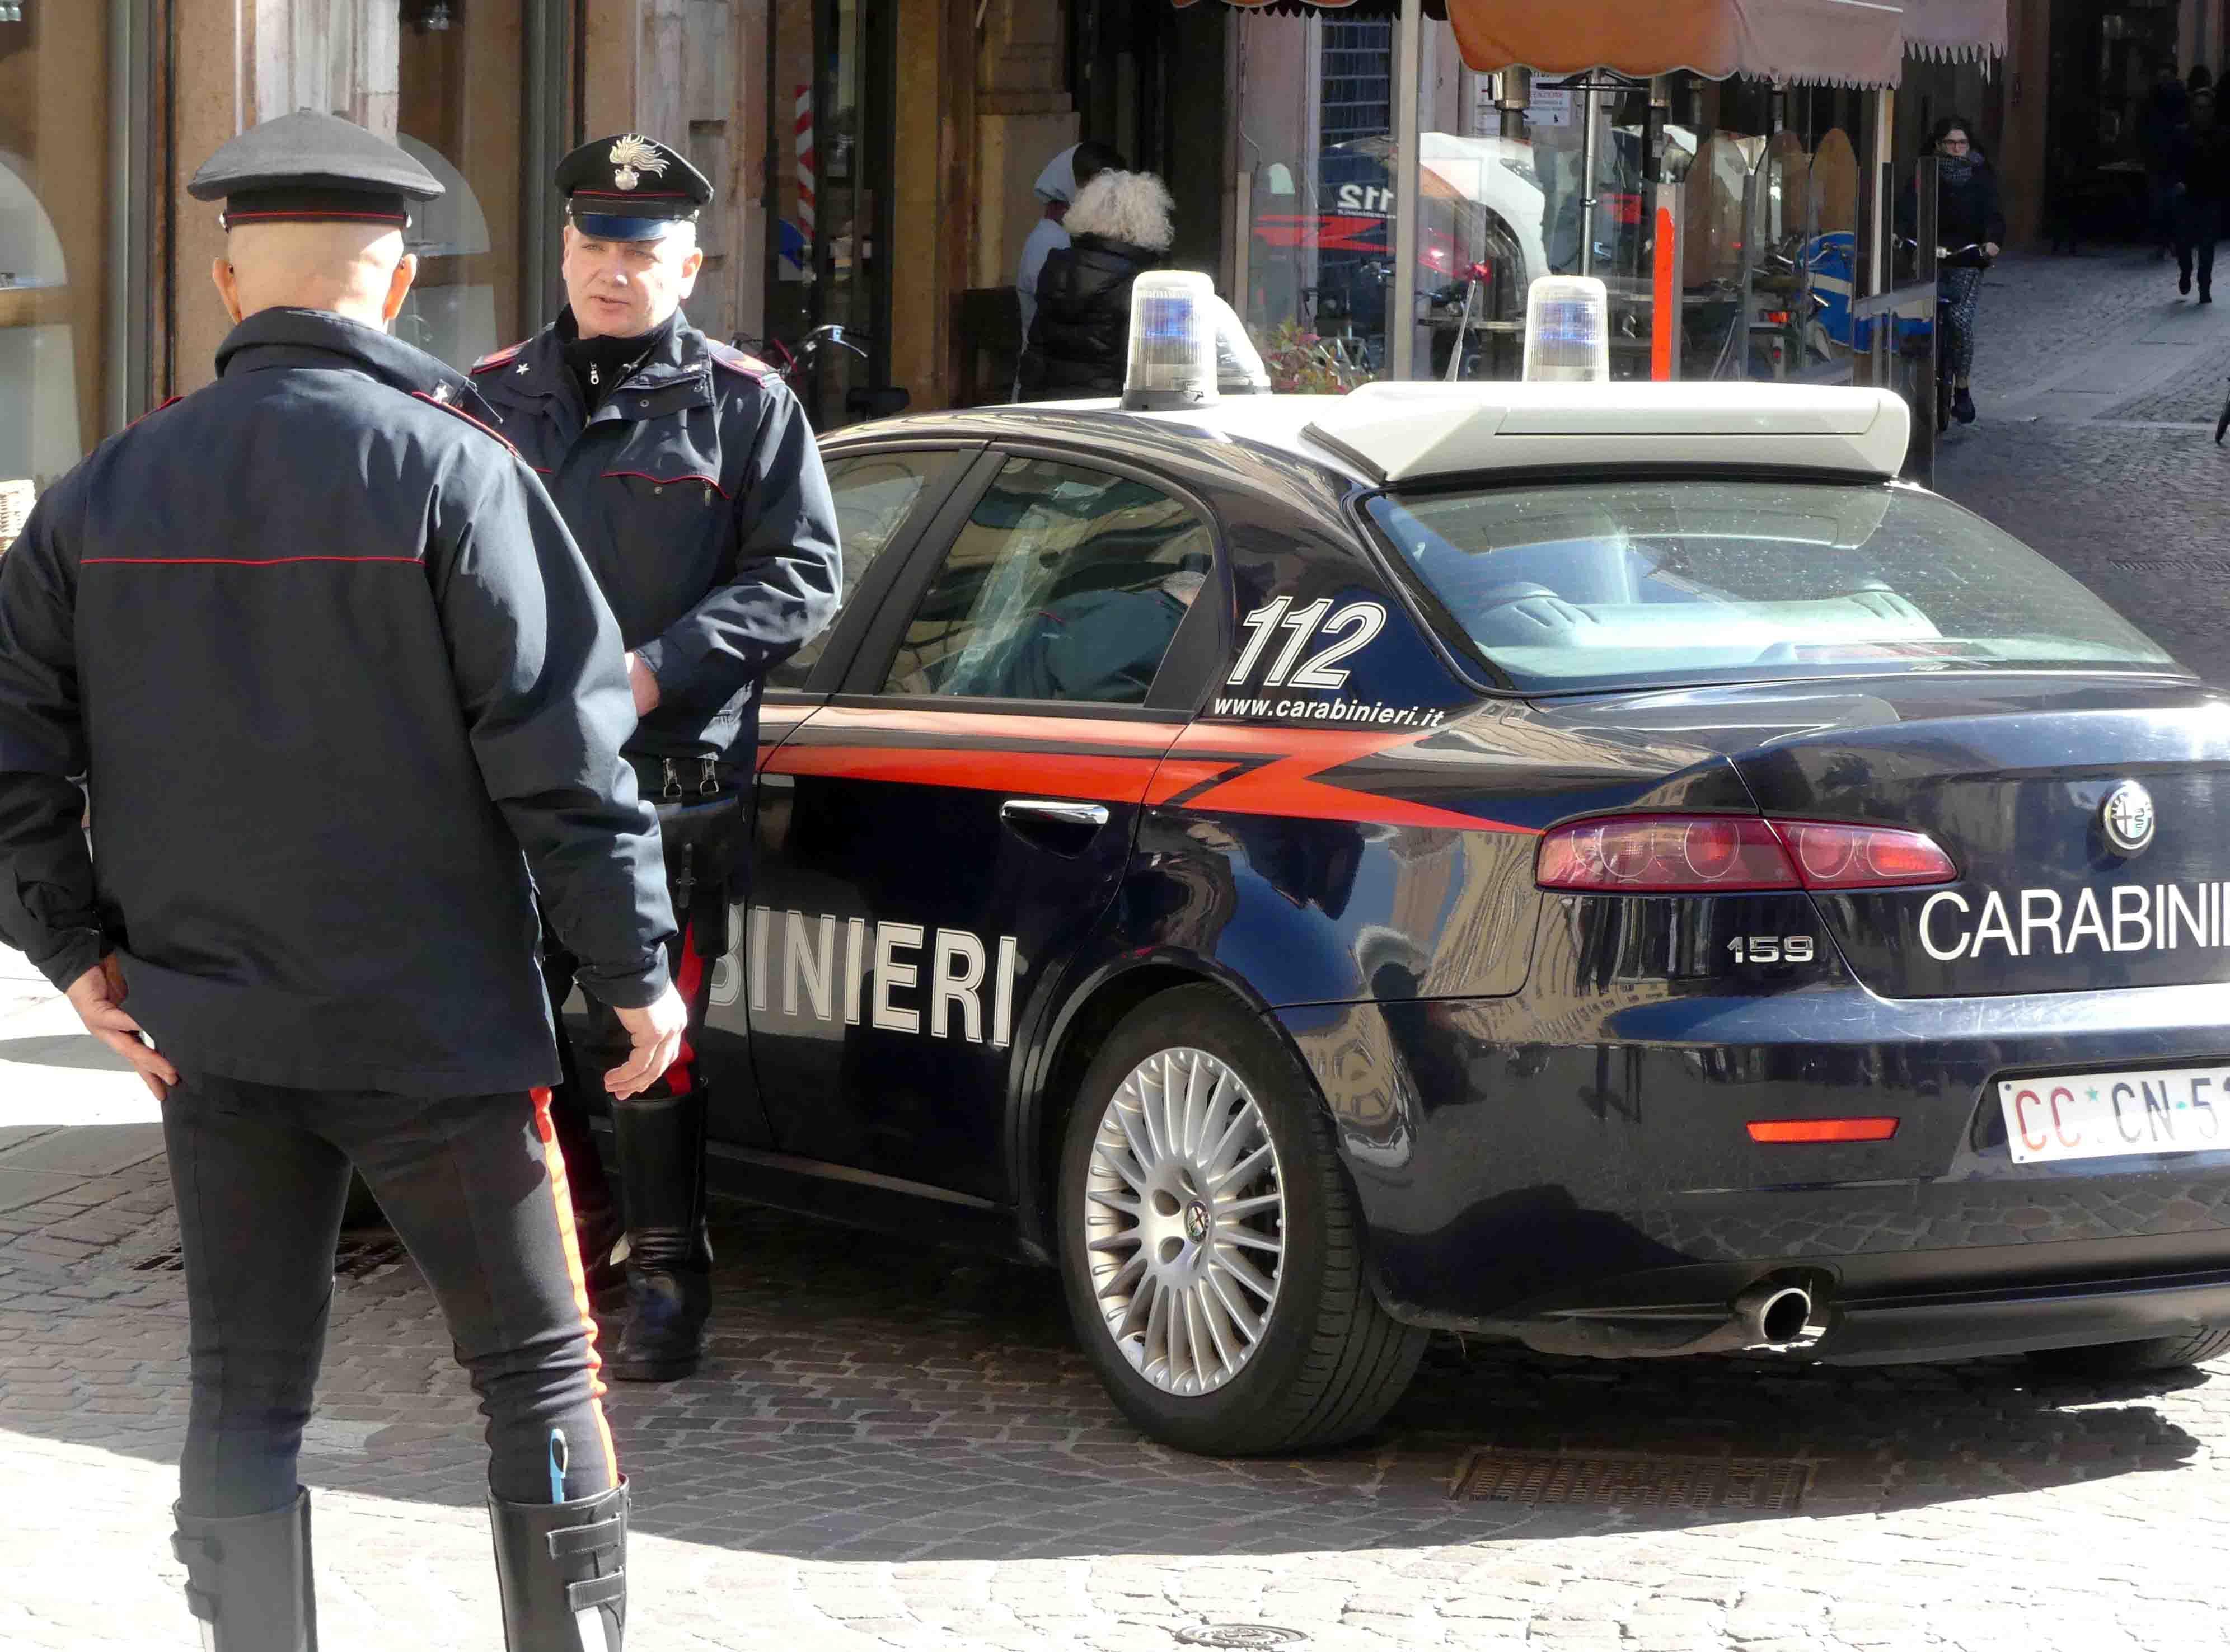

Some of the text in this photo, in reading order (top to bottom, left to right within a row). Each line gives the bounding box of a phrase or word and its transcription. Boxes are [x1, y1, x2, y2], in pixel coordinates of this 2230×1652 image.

[1226, 595, 1386, 689] 112
[1214, 697, 1445, 728] www.carabinieri.it
[1727, 936, 1814, 963] 159
